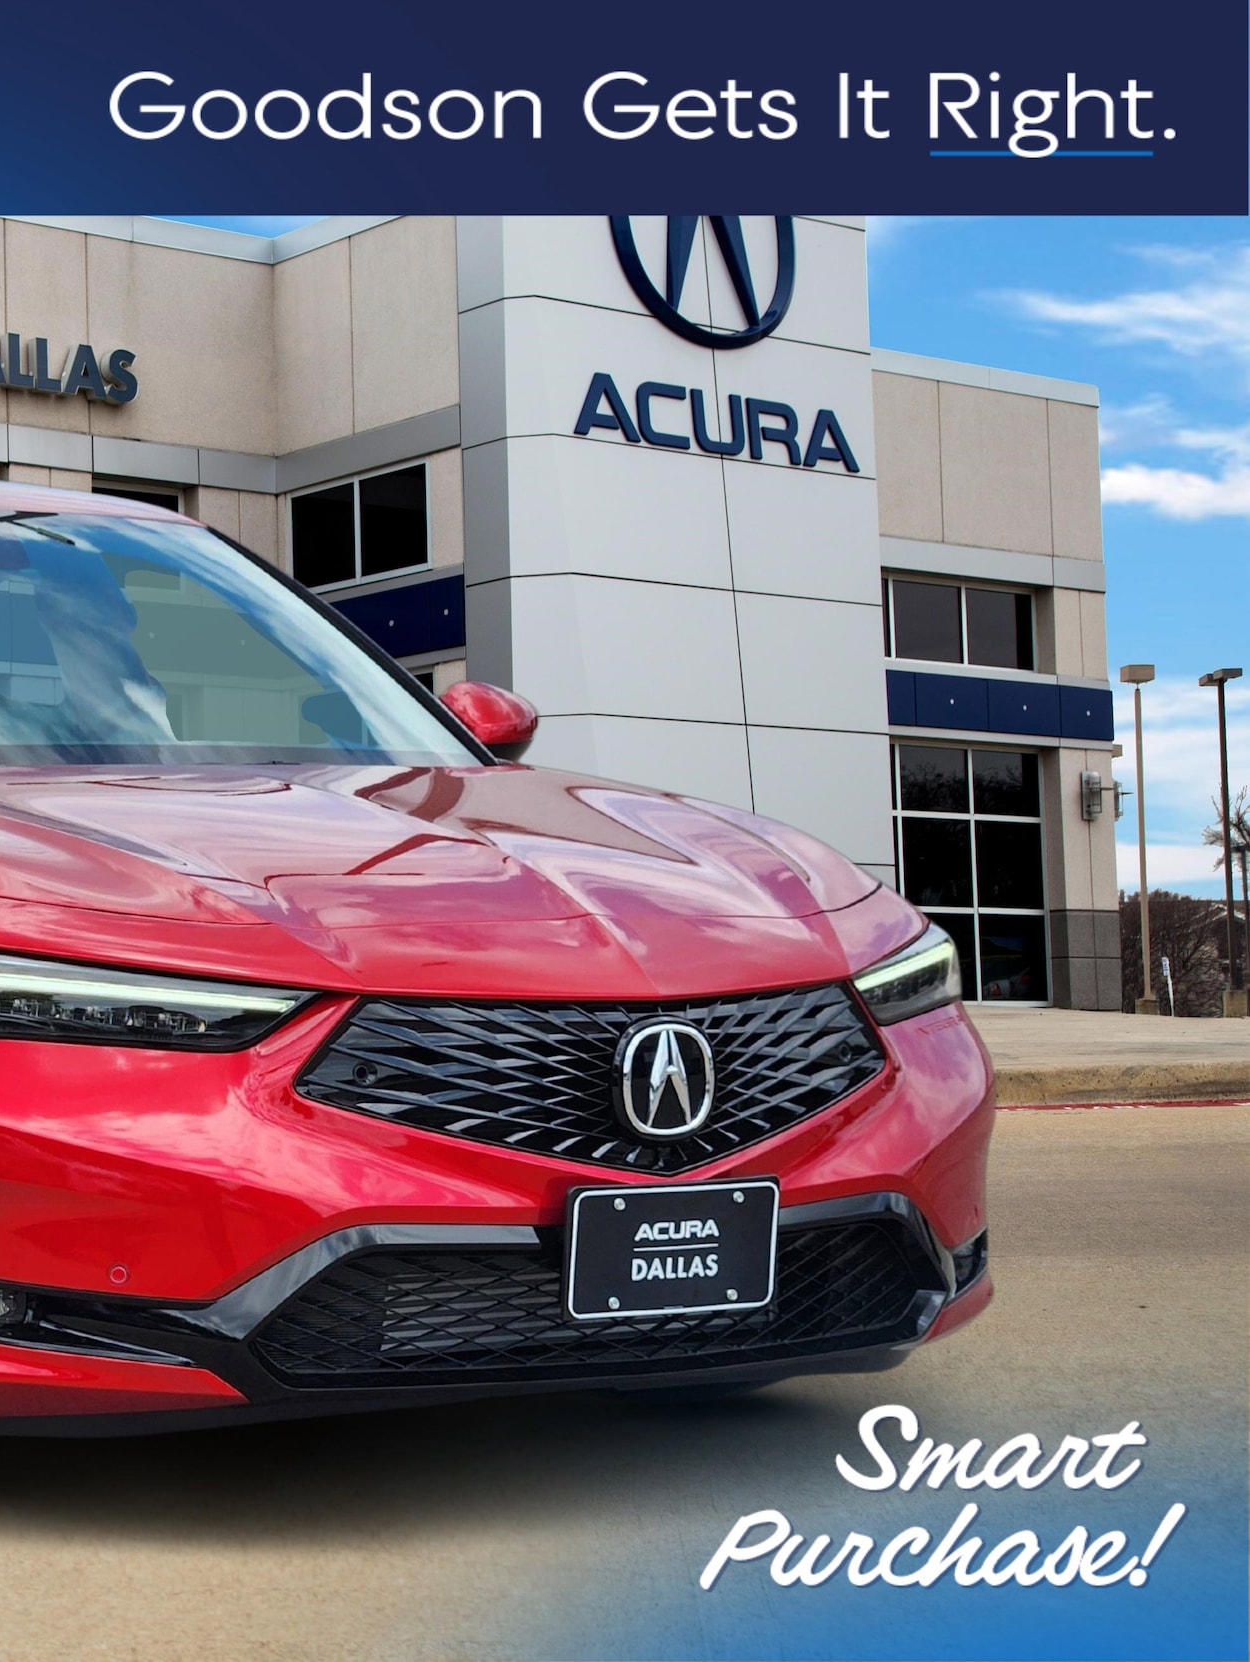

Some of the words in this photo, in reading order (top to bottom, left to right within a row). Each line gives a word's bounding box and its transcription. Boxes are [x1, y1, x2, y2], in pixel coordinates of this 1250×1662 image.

[574, 372, 860, 472] ACURA
[634, 1219, 719, 1241] ACURA
[631, 1254, 718, 1281] DALLAS
